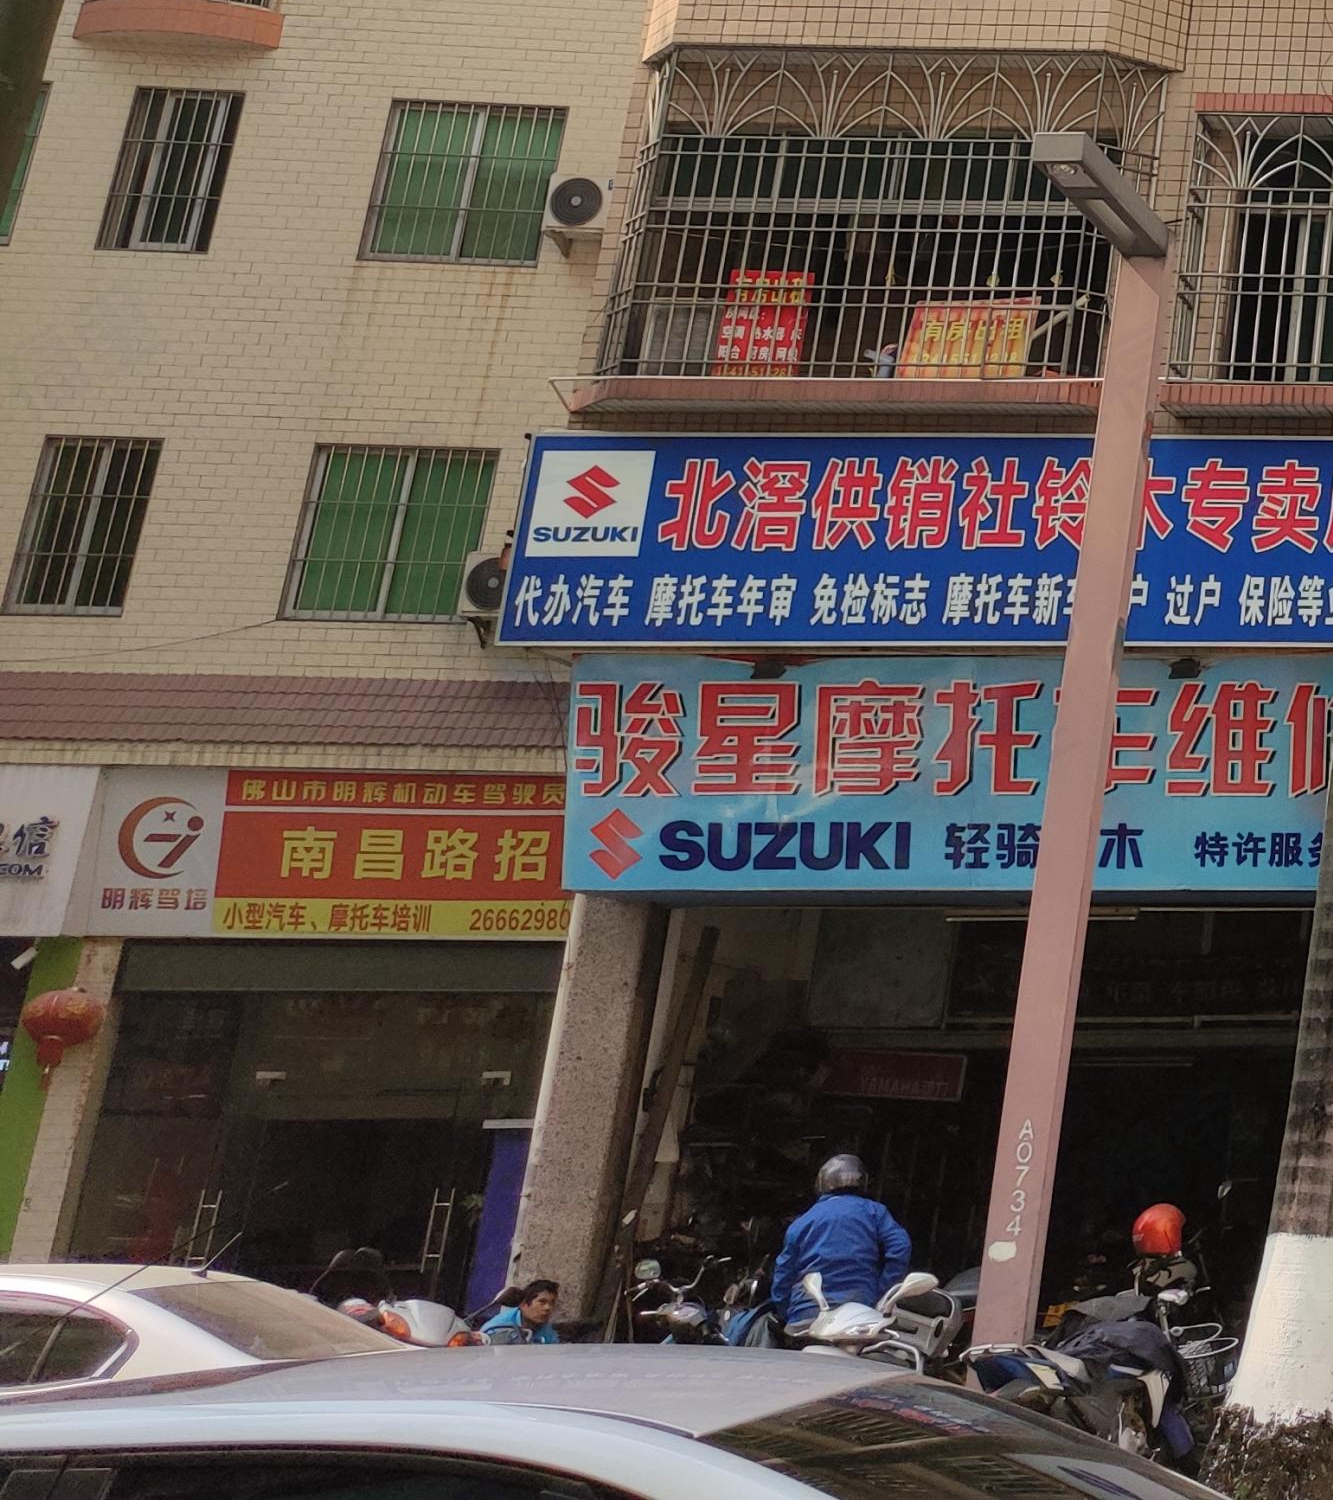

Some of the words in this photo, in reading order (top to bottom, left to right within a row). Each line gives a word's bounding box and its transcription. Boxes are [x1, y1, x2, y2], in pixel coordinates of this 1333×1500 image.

[532, 525, 639, 543] SUZUKI
[514, 573, 634, 627] 代办汽车
[645, 573, 798, 627] 摩托车年审
[810, 573, 930, 627] 免检标志
[1164, 574, 1221, 627] 过户
[242, 779, 566, 806] 佛山市明辉机动车驾驶员
[280, 826, 551, 882] 南昌路招
[658, 820, 912, 871] SUZUKI
[945, 823, 1145, 869] 轻骑木
[222, 901, 432, 933] 小型汽车、摩托车培训
[469, 908, 571, 932] 26662980
